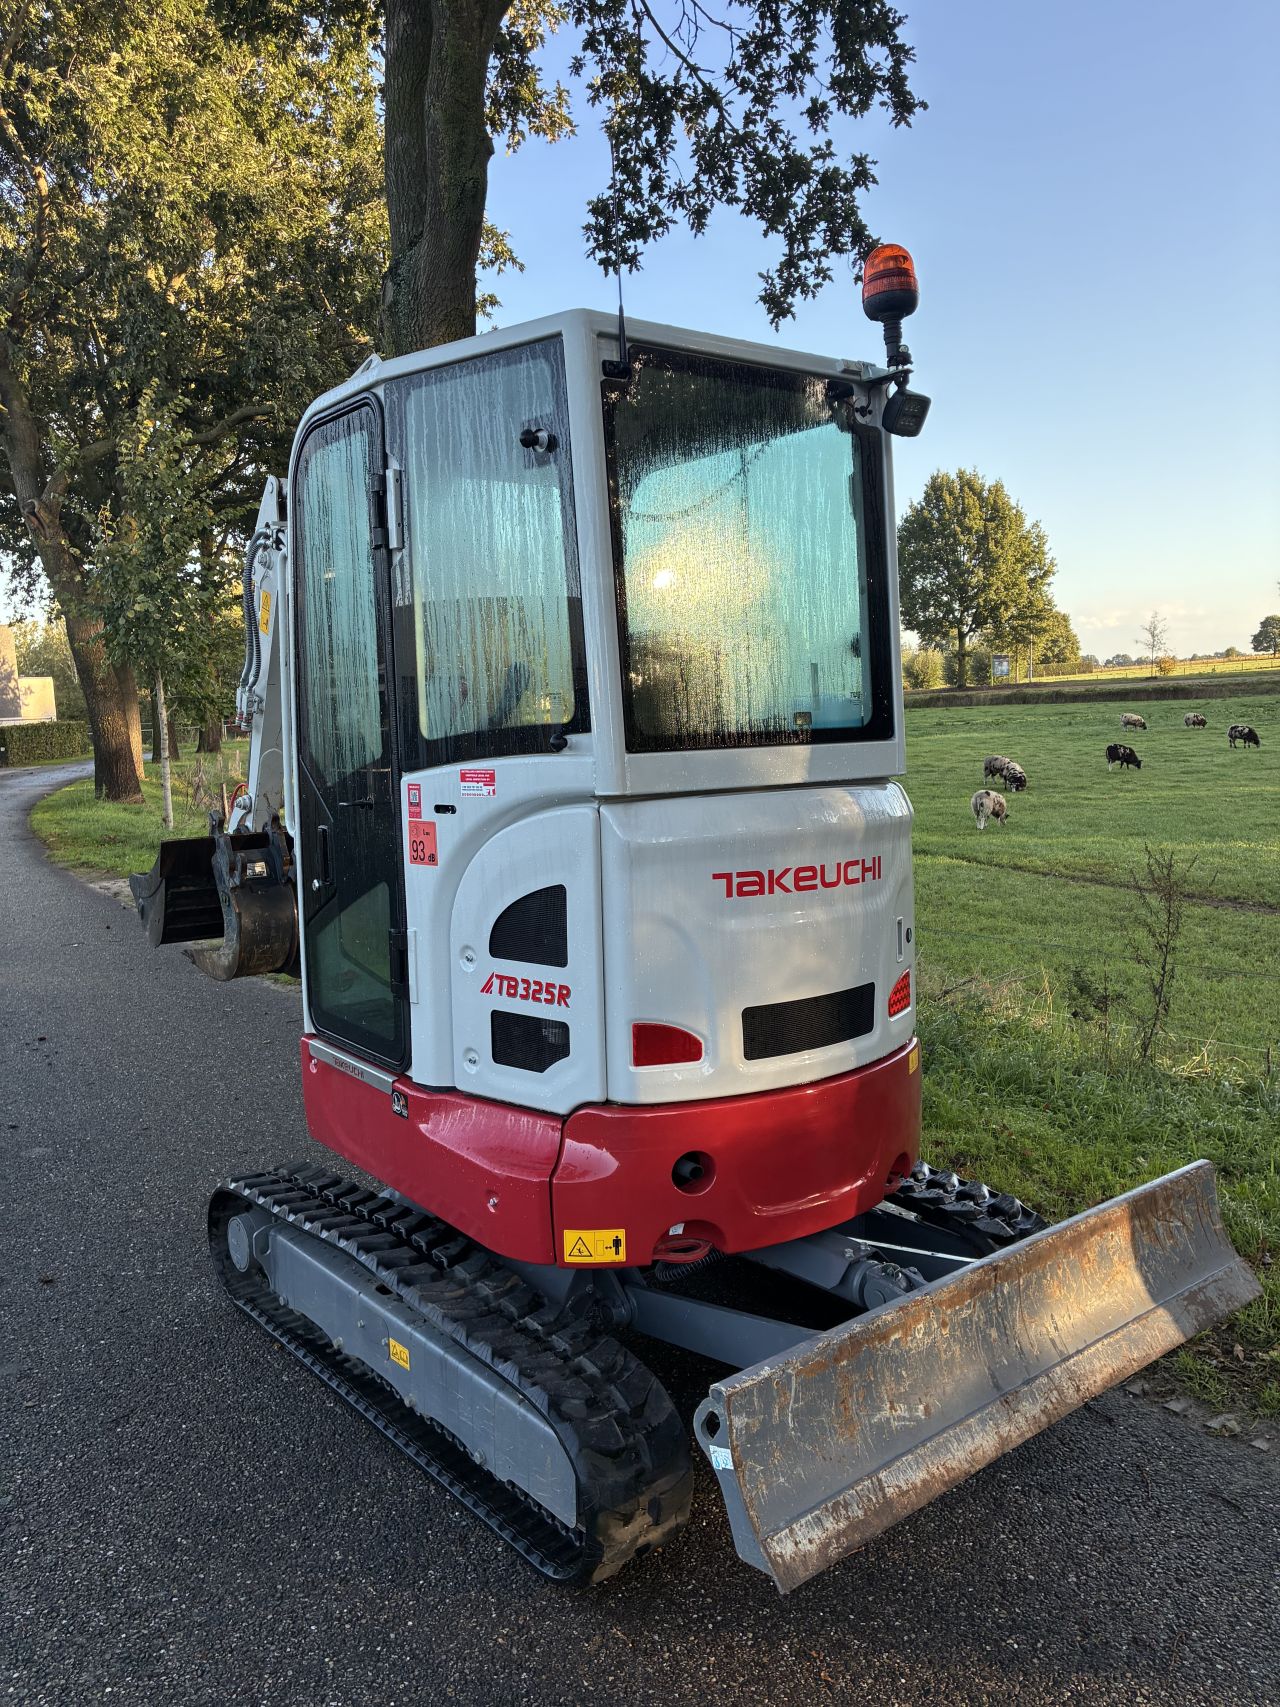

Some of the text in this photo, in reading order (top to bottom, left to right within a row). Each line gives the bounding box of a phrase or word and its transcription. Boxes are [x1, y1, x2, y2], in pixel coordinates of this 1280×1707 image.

[412, 840, 425, 861] 93
[428, 853, 436, 862] dB
[712, 855, 882, 899] TAKEUCHI
[495, 973, 571, 1008] TB325R
